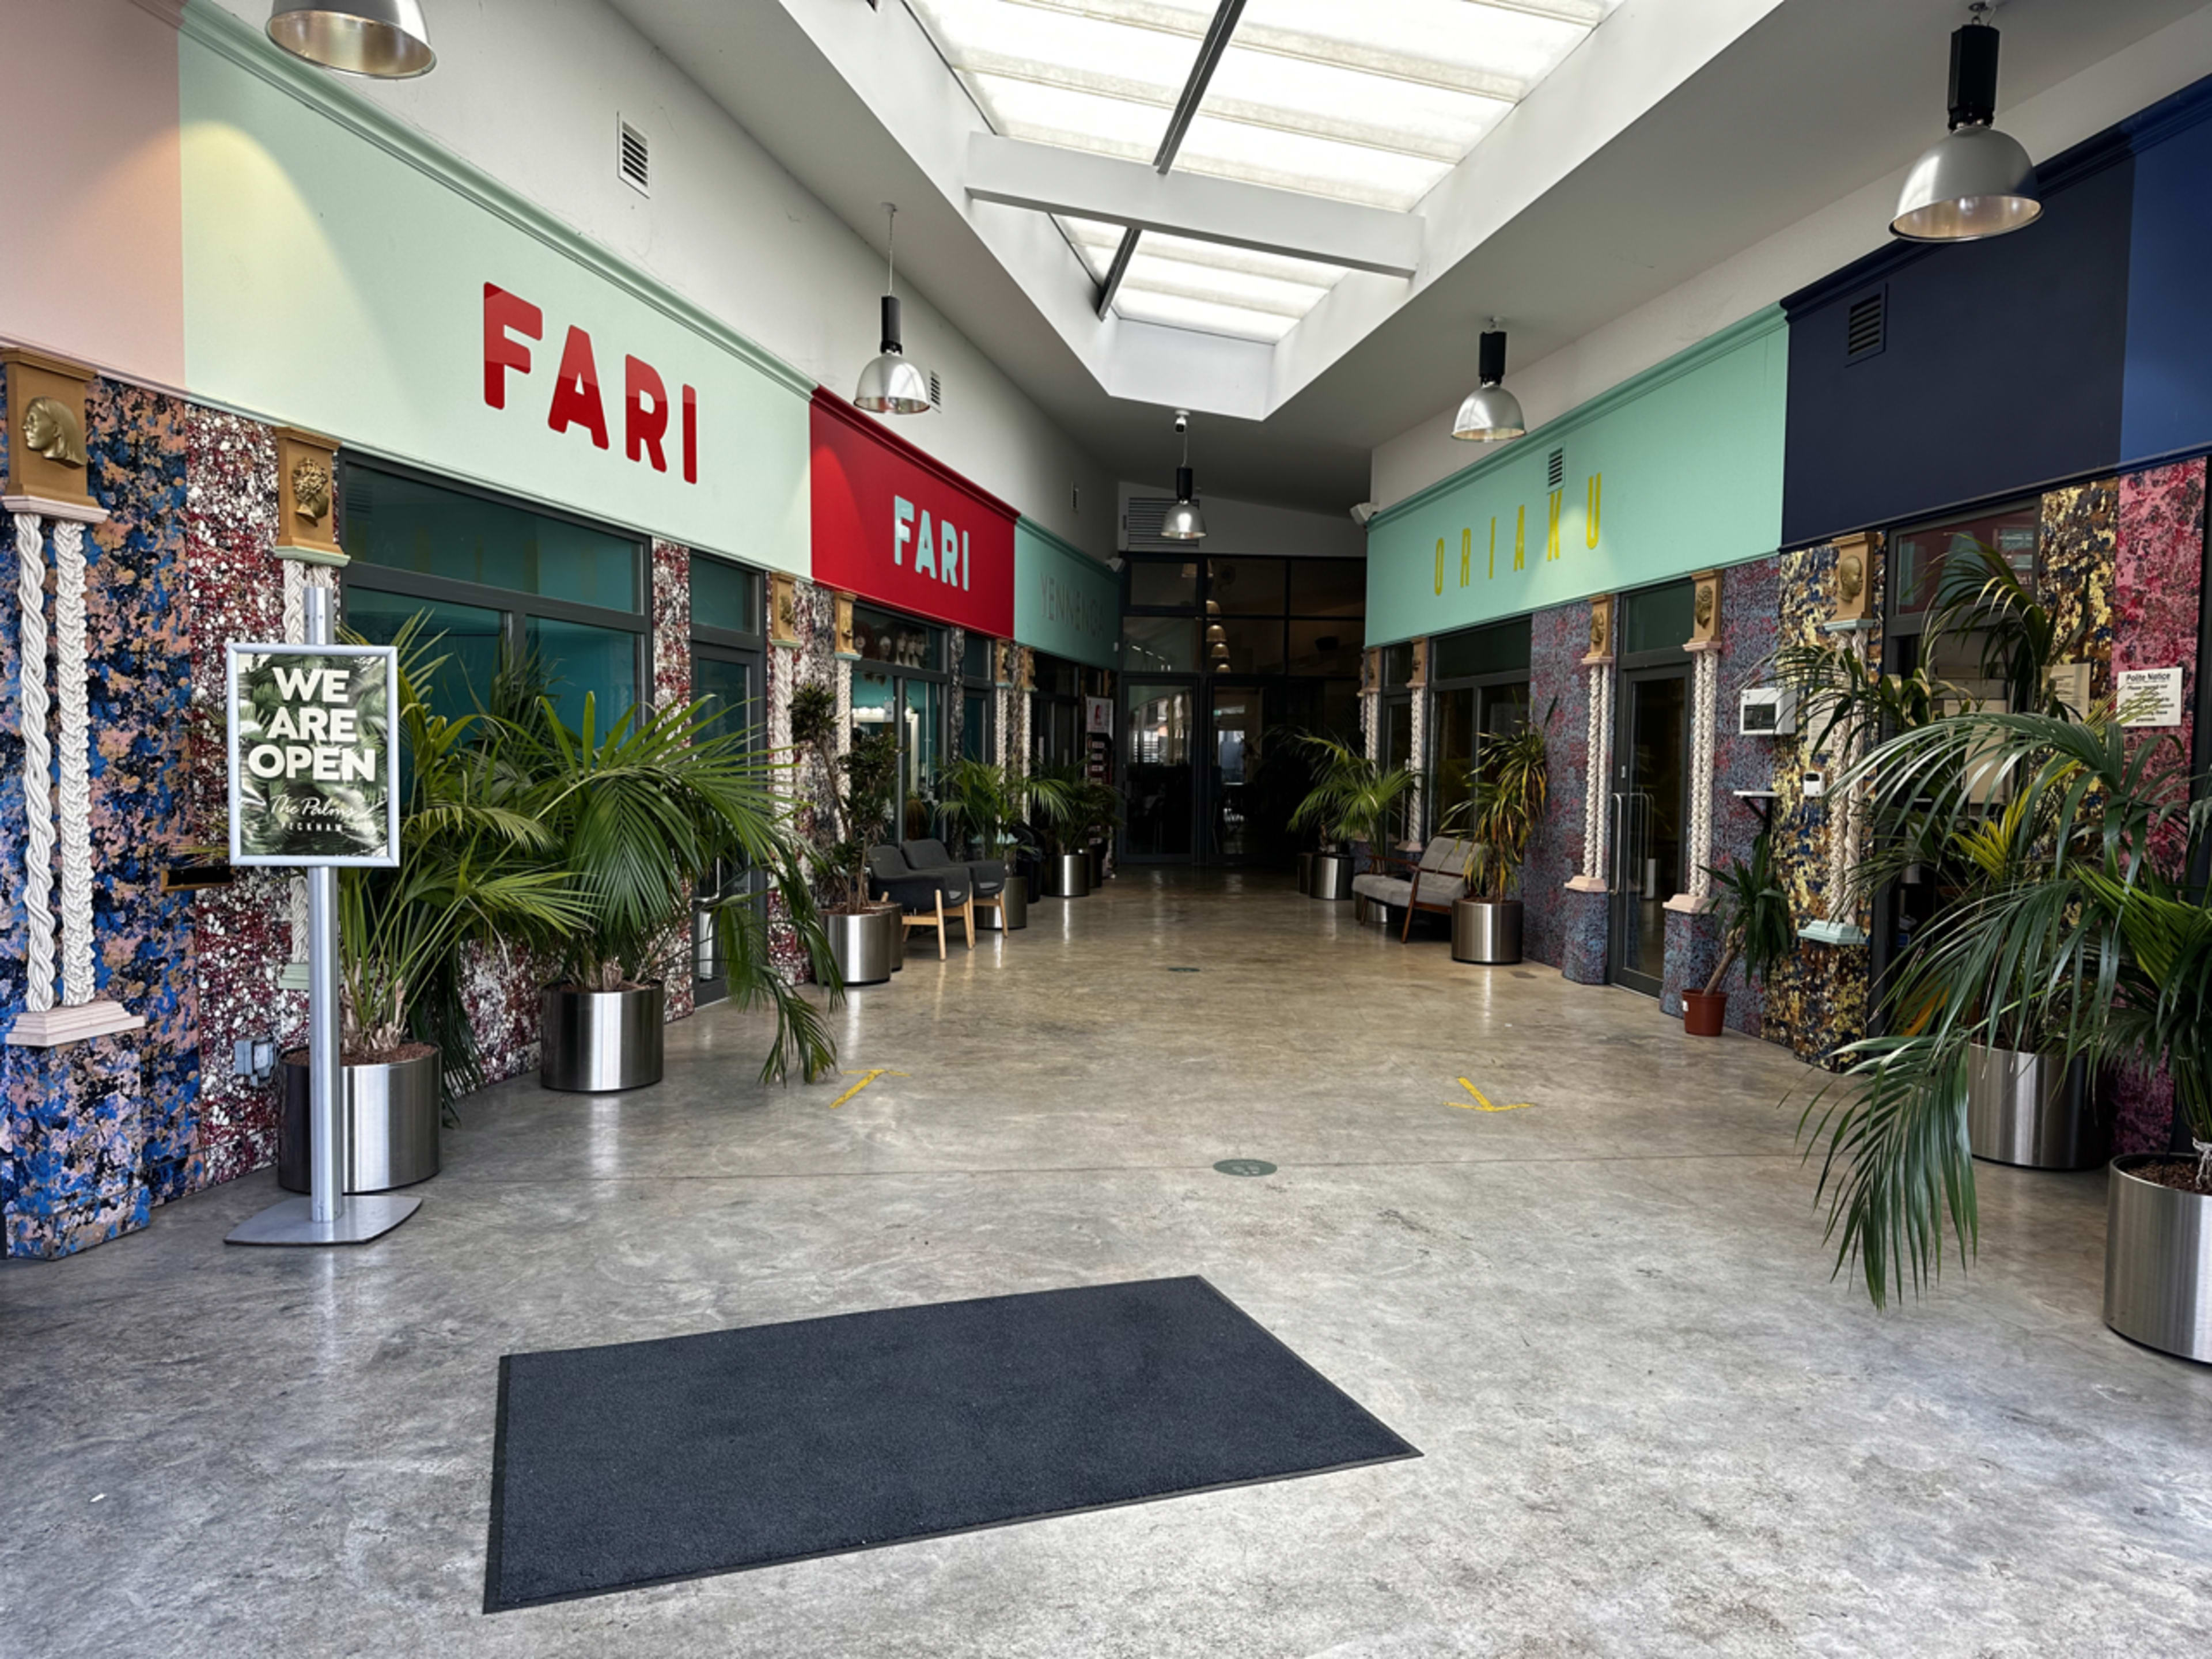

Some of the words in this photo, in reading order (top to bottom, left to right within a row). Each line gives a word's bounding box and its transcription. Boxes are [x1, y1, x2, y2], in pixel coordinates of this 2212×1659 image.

[483, 281, 698, 485] FARI
[894, 494, 969, 592] FARI
[272, 667, 350, 702] WE
[266, 706, 357, 742] ARE
[248, 744, 376, 782] OPEN
[270, 793, 300, 815] The
[300, 796, 355, 818] Palms
[281, 821, 343, 832] PECKHAM
